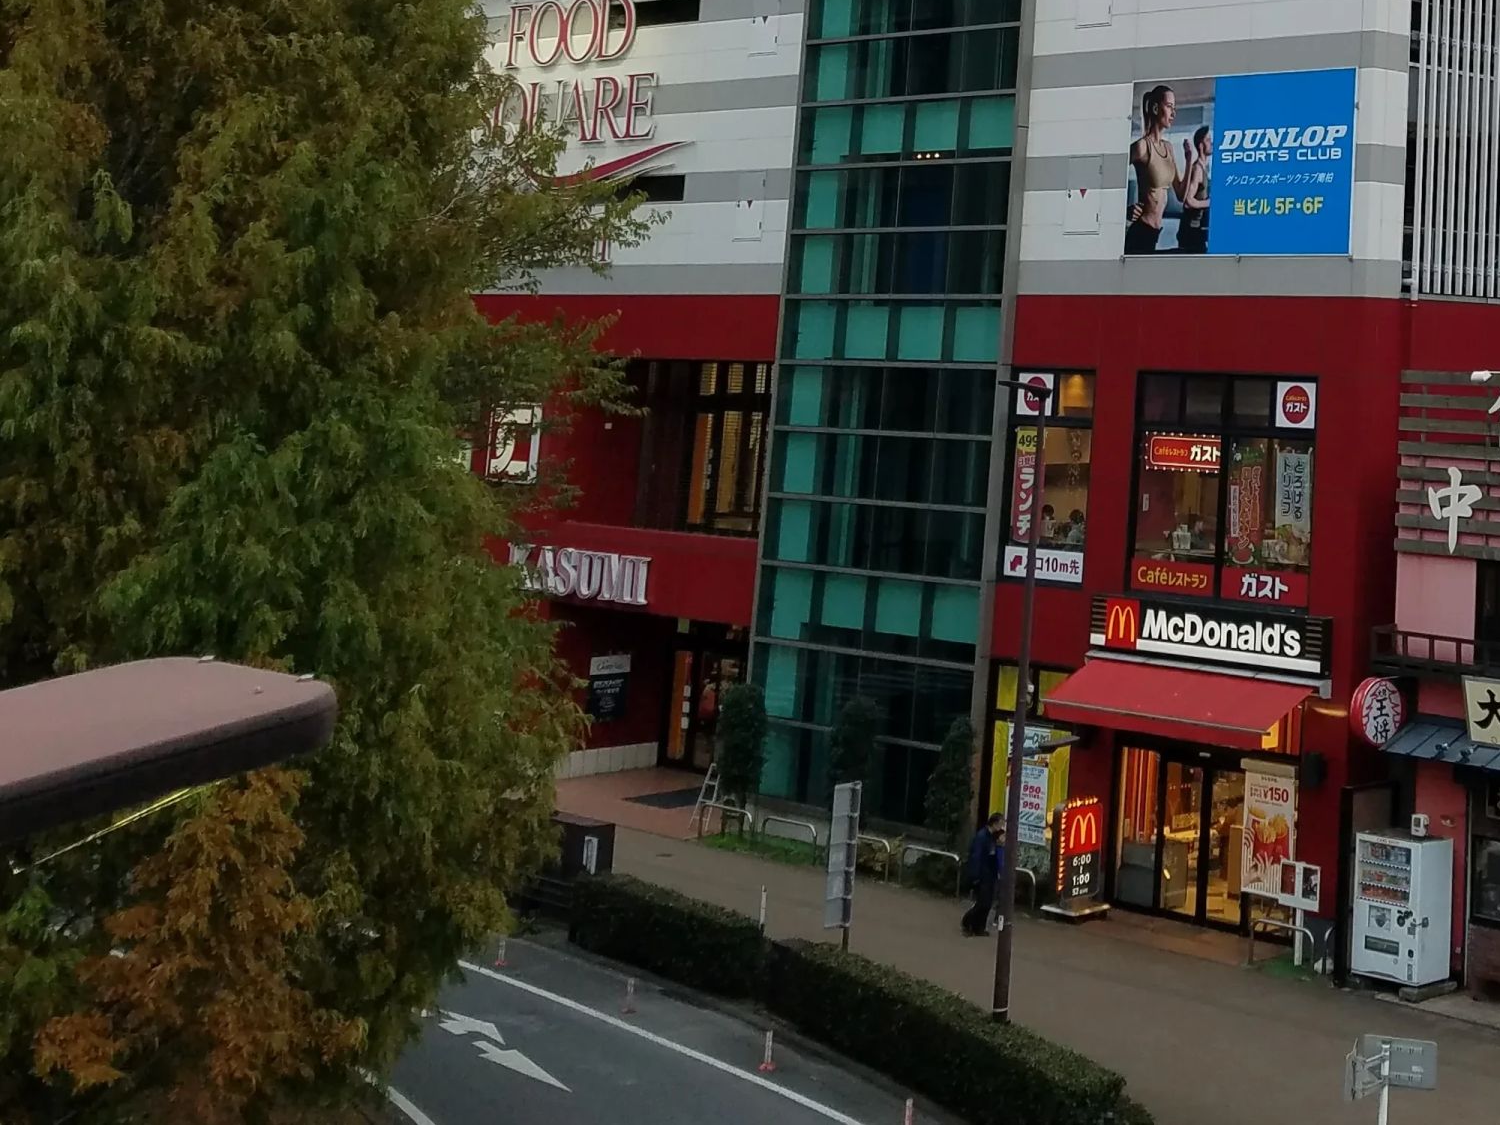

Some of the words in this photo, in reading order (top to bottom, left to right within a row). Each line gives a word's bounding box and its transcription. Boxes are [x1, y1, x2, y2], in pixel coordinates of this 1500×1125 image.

[1218, 125, 1348, 150] DUNLOP
[1221, 150, 1290, 164] SPORTS
[1296, 148, 1342, 161] CLUB
[1233, 198, 1271, 216] 当ビル
[1285, 402, 1308, 413] ガスト
[1189, 444, 1221, 463] ガスト
[1017, 467, 1036, 536] ランチ
[1293, 457, 1306, 523] とろける
[507, 542, 652, 606] KASUMI
[1024, 555, 1081, 578] 口10m先
[1137, 565, 1208, 589] Caféレストラン
[1240, 572, 1289, 600] ガスト
[1142, 608, 1300, 657] McDonald's
[1372, 697, 1391, 744] 王将
[1263, 785, 1290, 804] ¥150
[1072, 853, 1092, 867] 6:00
[1072, 872, 1091, 887] 1:00
